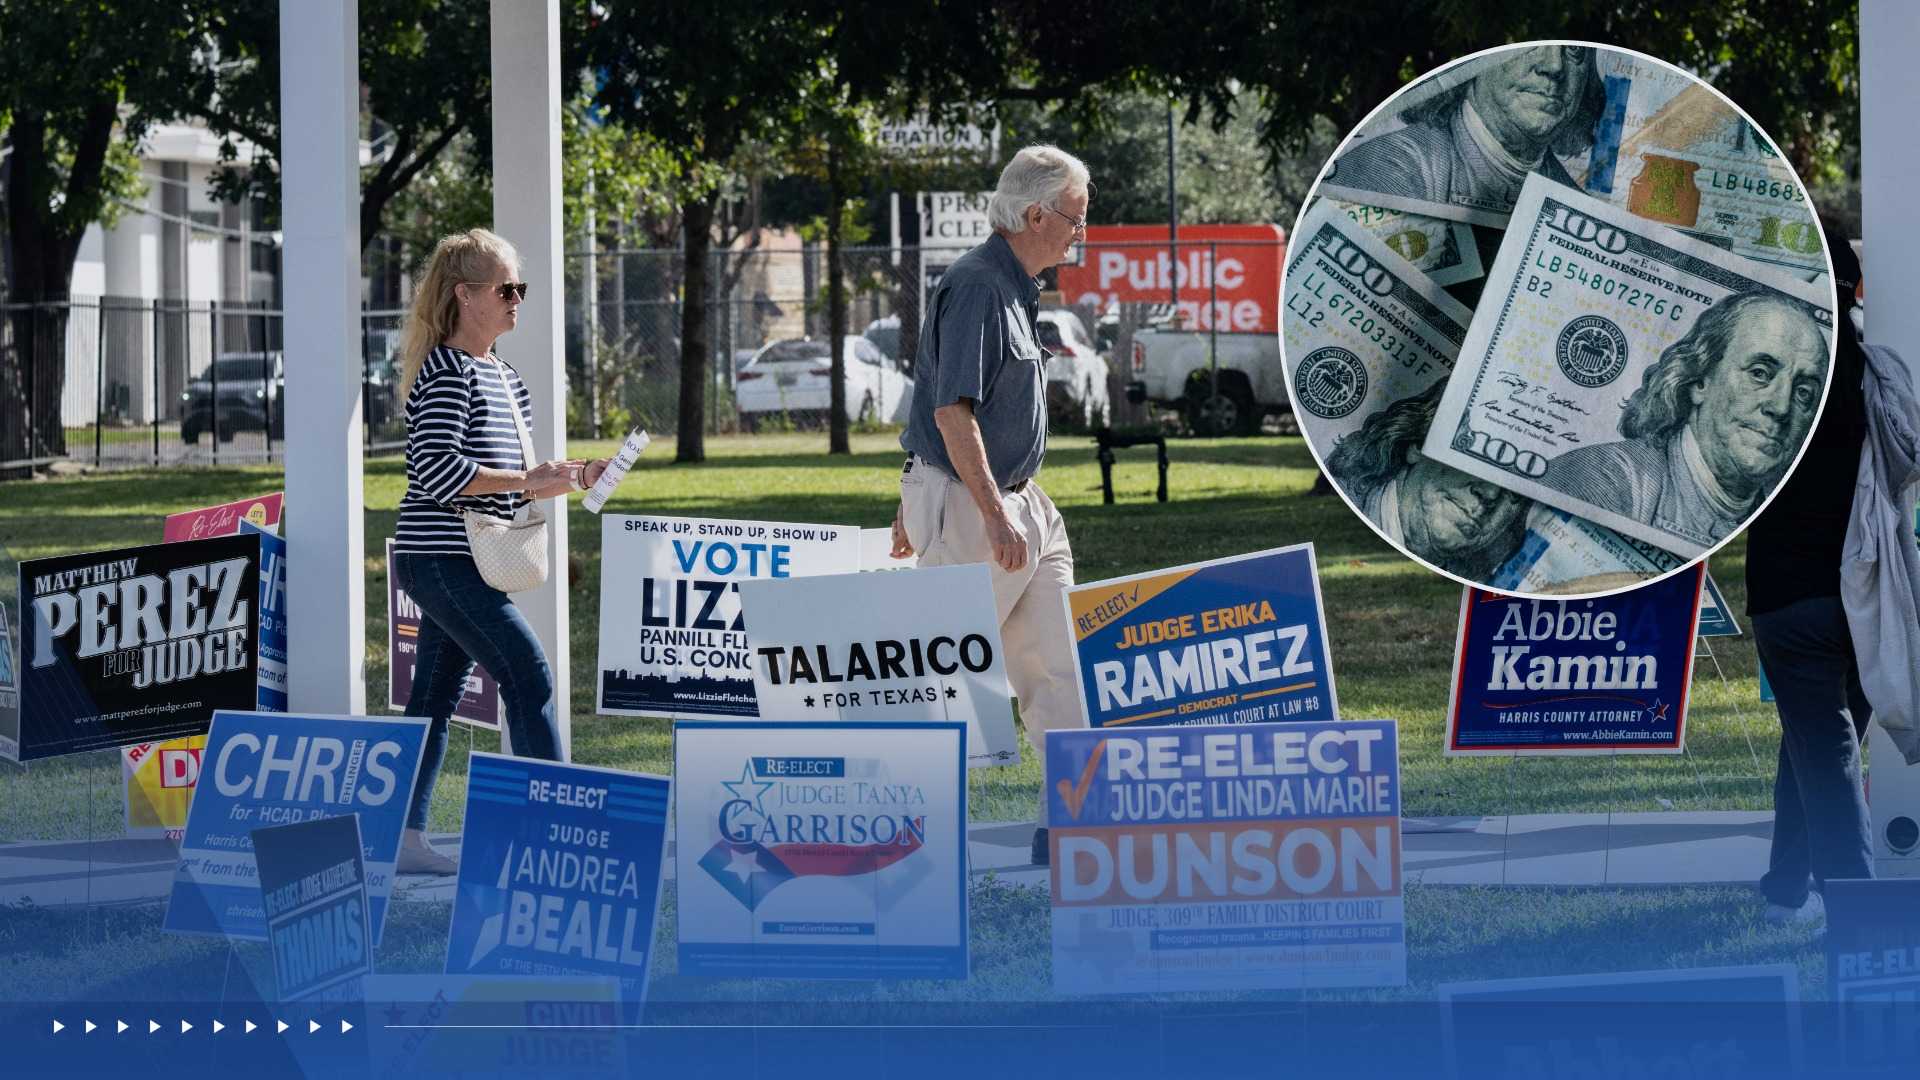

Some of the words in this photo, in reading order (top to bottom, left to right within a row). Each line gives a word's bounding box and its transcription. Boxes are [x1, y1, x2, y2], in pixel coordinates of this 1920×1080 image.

[1545, 207, 1628, 256] 100
[1099, 251, 1245, 290] Public
[1316, 233, 1395, 298] 100
[1548, 233, 1610, 270] FEDERAL
[1608, 255, 1673, 293] RESERVE
[1673, 282, 1713, 306] NOTE
[1315, 258, 1370, 305] FEDERAL
[1368, 299, 1426, 347] RESERVE
[1527, 274, 1553, 299] B2
[1287, 292, 1325, 328] L12
[1470, 430, 1549, 479] 100
[624, 520, 668, 533] SPEAK
[673, 523, 693, 536] UP,
[698, 524, 743, 537] STAND
[748, 527, 767, 539] UP,
[772, 528, 815, 541] SHOW
[819, 530, 838, 541] UP
[34, 557, 139, 596] MATTHEW
[672, 540, 790, 577] VOTE
[31, 556, 251, 669] PEREZ
[1077, 592, 1129, 634] RE-ELECT
[1116, 614, 1197, 650] JUDGE
[1201, 600, 1277, 634] ERIKA
[1493, 599, 1617, 641] Abbie
[103, 649, 140, 678] FOR
[133, 626, 248, 689] JUDGE
[641, 629, 717, 649] PANNILL
[641, 647, 683, 667] U.S.
[758, 633, 993, 685] TALARICO
[1094, 624, 1314, 712] RAMIREZ
[1487, 640, 1658, 690] Kamin
[73, 699, 203, 726] www.mattperezforjudge.com
[823, 691, 862, 708] FOR
[869, 687, 937, 706] TEXAS
[1178, 694, 1238, 715] DEMOCRAT
[1233, 706, 1265, 725] COURT
[1268, 703, 1279, 718] AT
[1282, 699, 1302, 716] LAW
[1305, 696, 1319, 711] #8
[1499, 711, 1540, 723] HARRIS
[1543, 711, 1586, 723] COUNTY
[1587, 710, 1643, 723] ATTORNEY
[1563, 729, 1673, 740] www.AbbieKamin.com
[214, 733, 402, 806] CHRIS
[767, 759, 834, 774] RE-ELECT
[1106, 729, 1383, 780] RE-ELECT
[229, 804, 253, 821] for
[259, 806, 303, 824] HCAD
[529, 780, 607, 810] RE-ELECT
[779, 782, 845, 807] JUDGE
[855, 782, 925, 805] TANYA
[1111, 782, 1203, 821] JUDGE
[1211, 779, 1297, 818] LINDA
[1304, 775, 1391, 814] MARIE
[204, 834, 237, 848] Harris
[549, 823, 610, 849] JUDGE
[718, 799, 927, 845] GARRISON
[202, 860, 233, 877] from
[235, 862, 257, 878] the
[515, 847, 639, 899] ANDREA
[1058, 826, 1392, 901] DUNSON
[506, 890, 644, 966] BEALL
[1207, 904, 1260, 926] FAMILY
[1264, 902, 1332, 924] DISTRICT
[1336, 901, 1385, 921] COURT
[1362, 926, 1392, 938] FIRST
[274, 898, 364, 992] THOMAS
